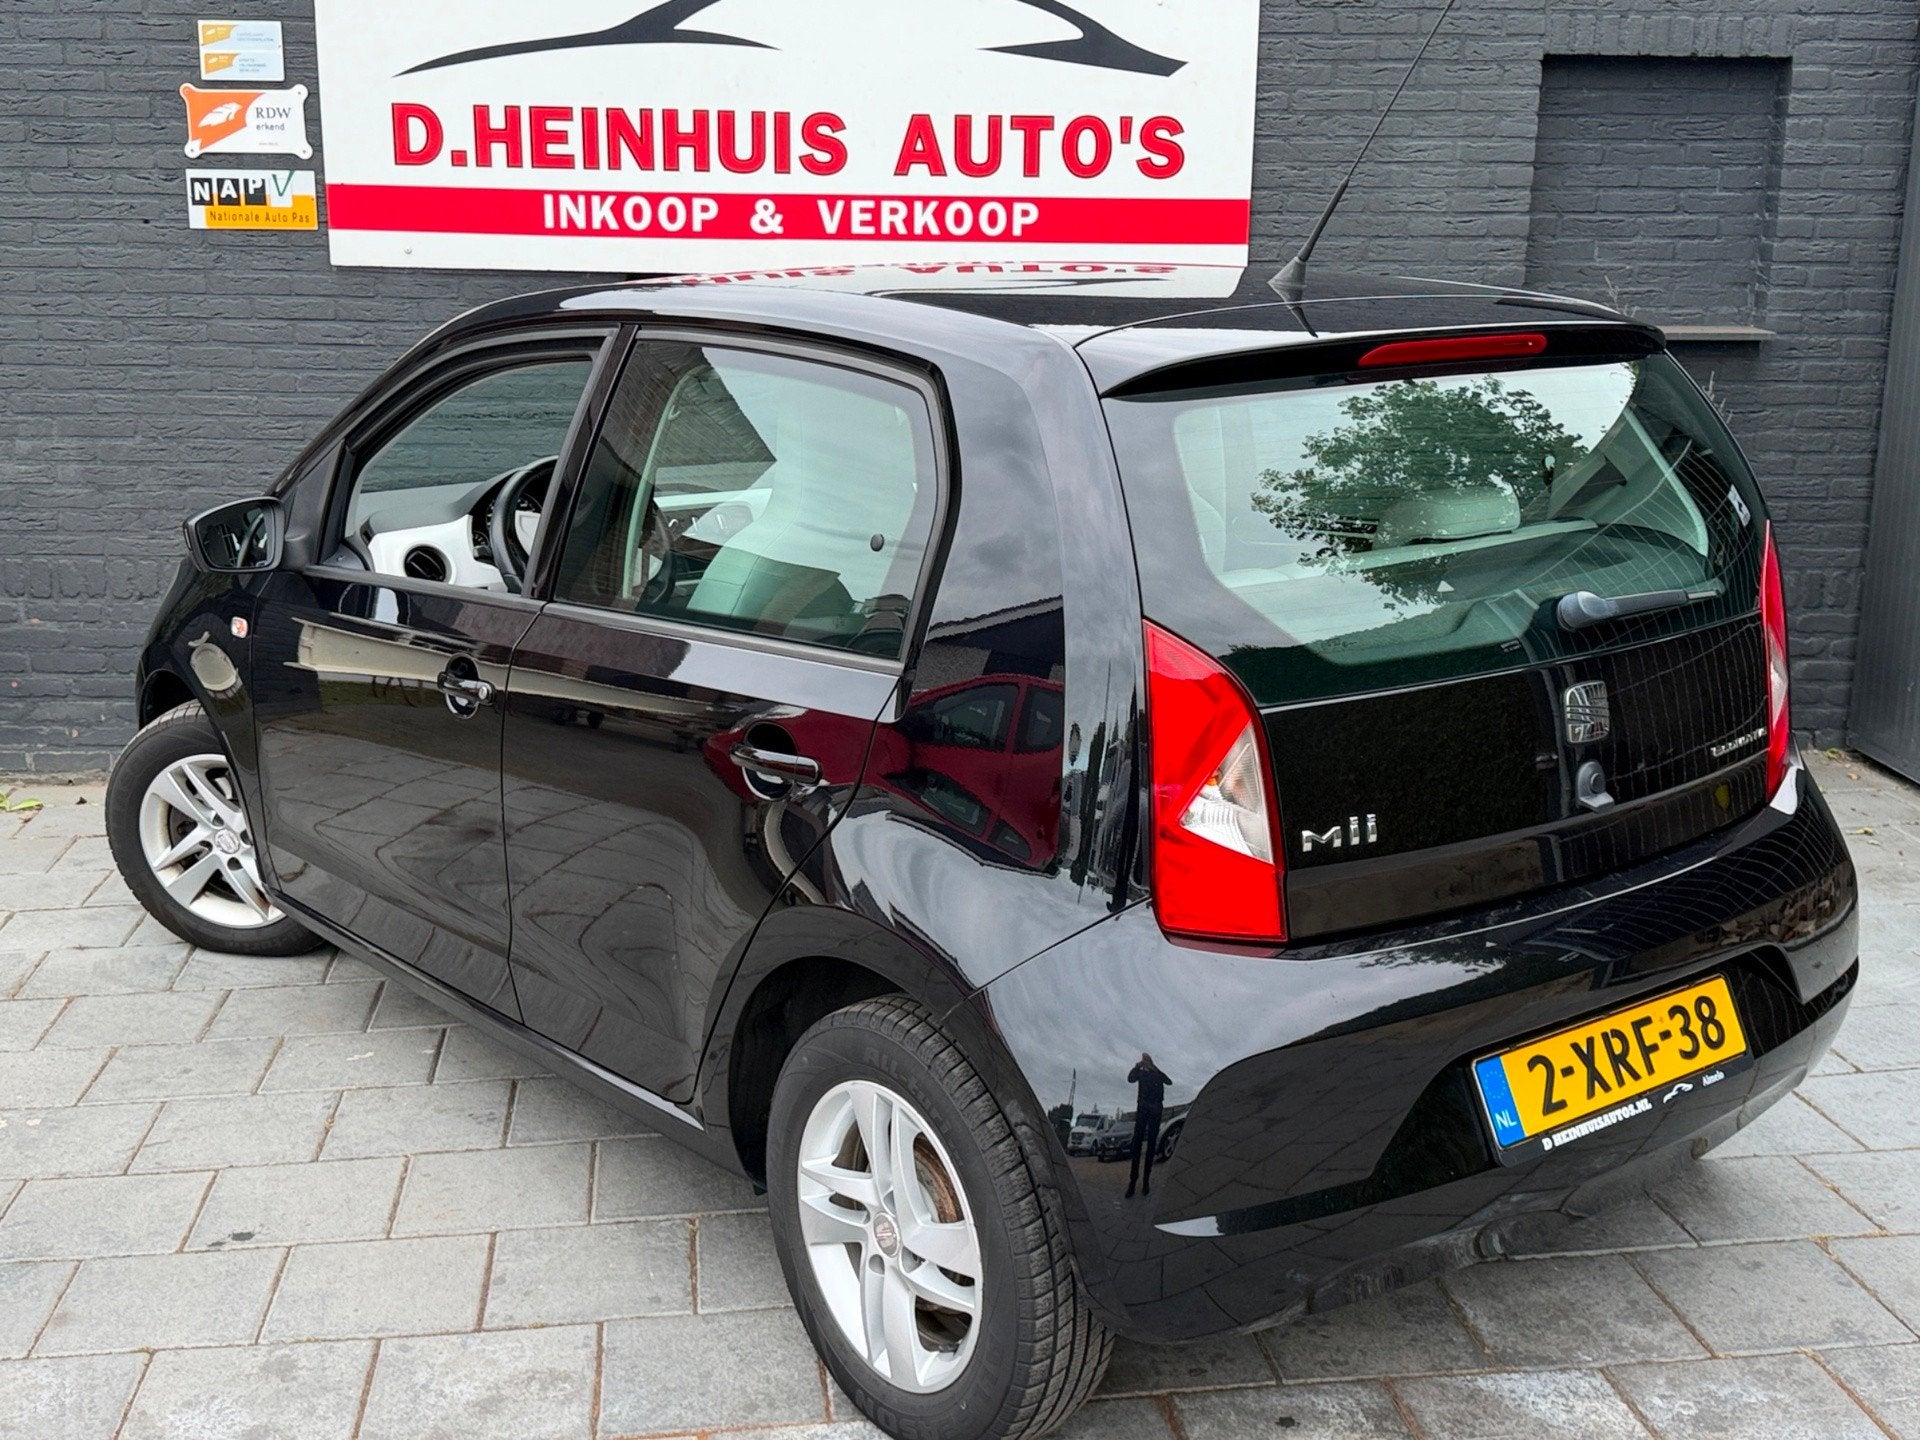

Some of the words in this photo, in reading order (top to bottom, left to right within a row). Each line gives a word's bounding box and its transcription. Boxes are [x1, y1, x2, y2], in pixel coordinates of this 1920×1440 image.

[256, 107, 290, 118] RDW
[256, 122, 285, 131] erkend
[391, 102, 848, 176] D.HEINHUIS
[893, 114, 1185, 179] AUTO'S
[210, 211, 260, 223] Nationale
[265, 212, 288, 223] Auto
[292, 212, 310, 223] Pas
[543, 194, 719, 232] INKOOP
[749, 199, 785, 234] &
[816, 200, 1040, 237] VERKOOP
[1527, 996, 1726, 1117] 2-XRF-38
[1494, 1112, 1517, 1132] NL
